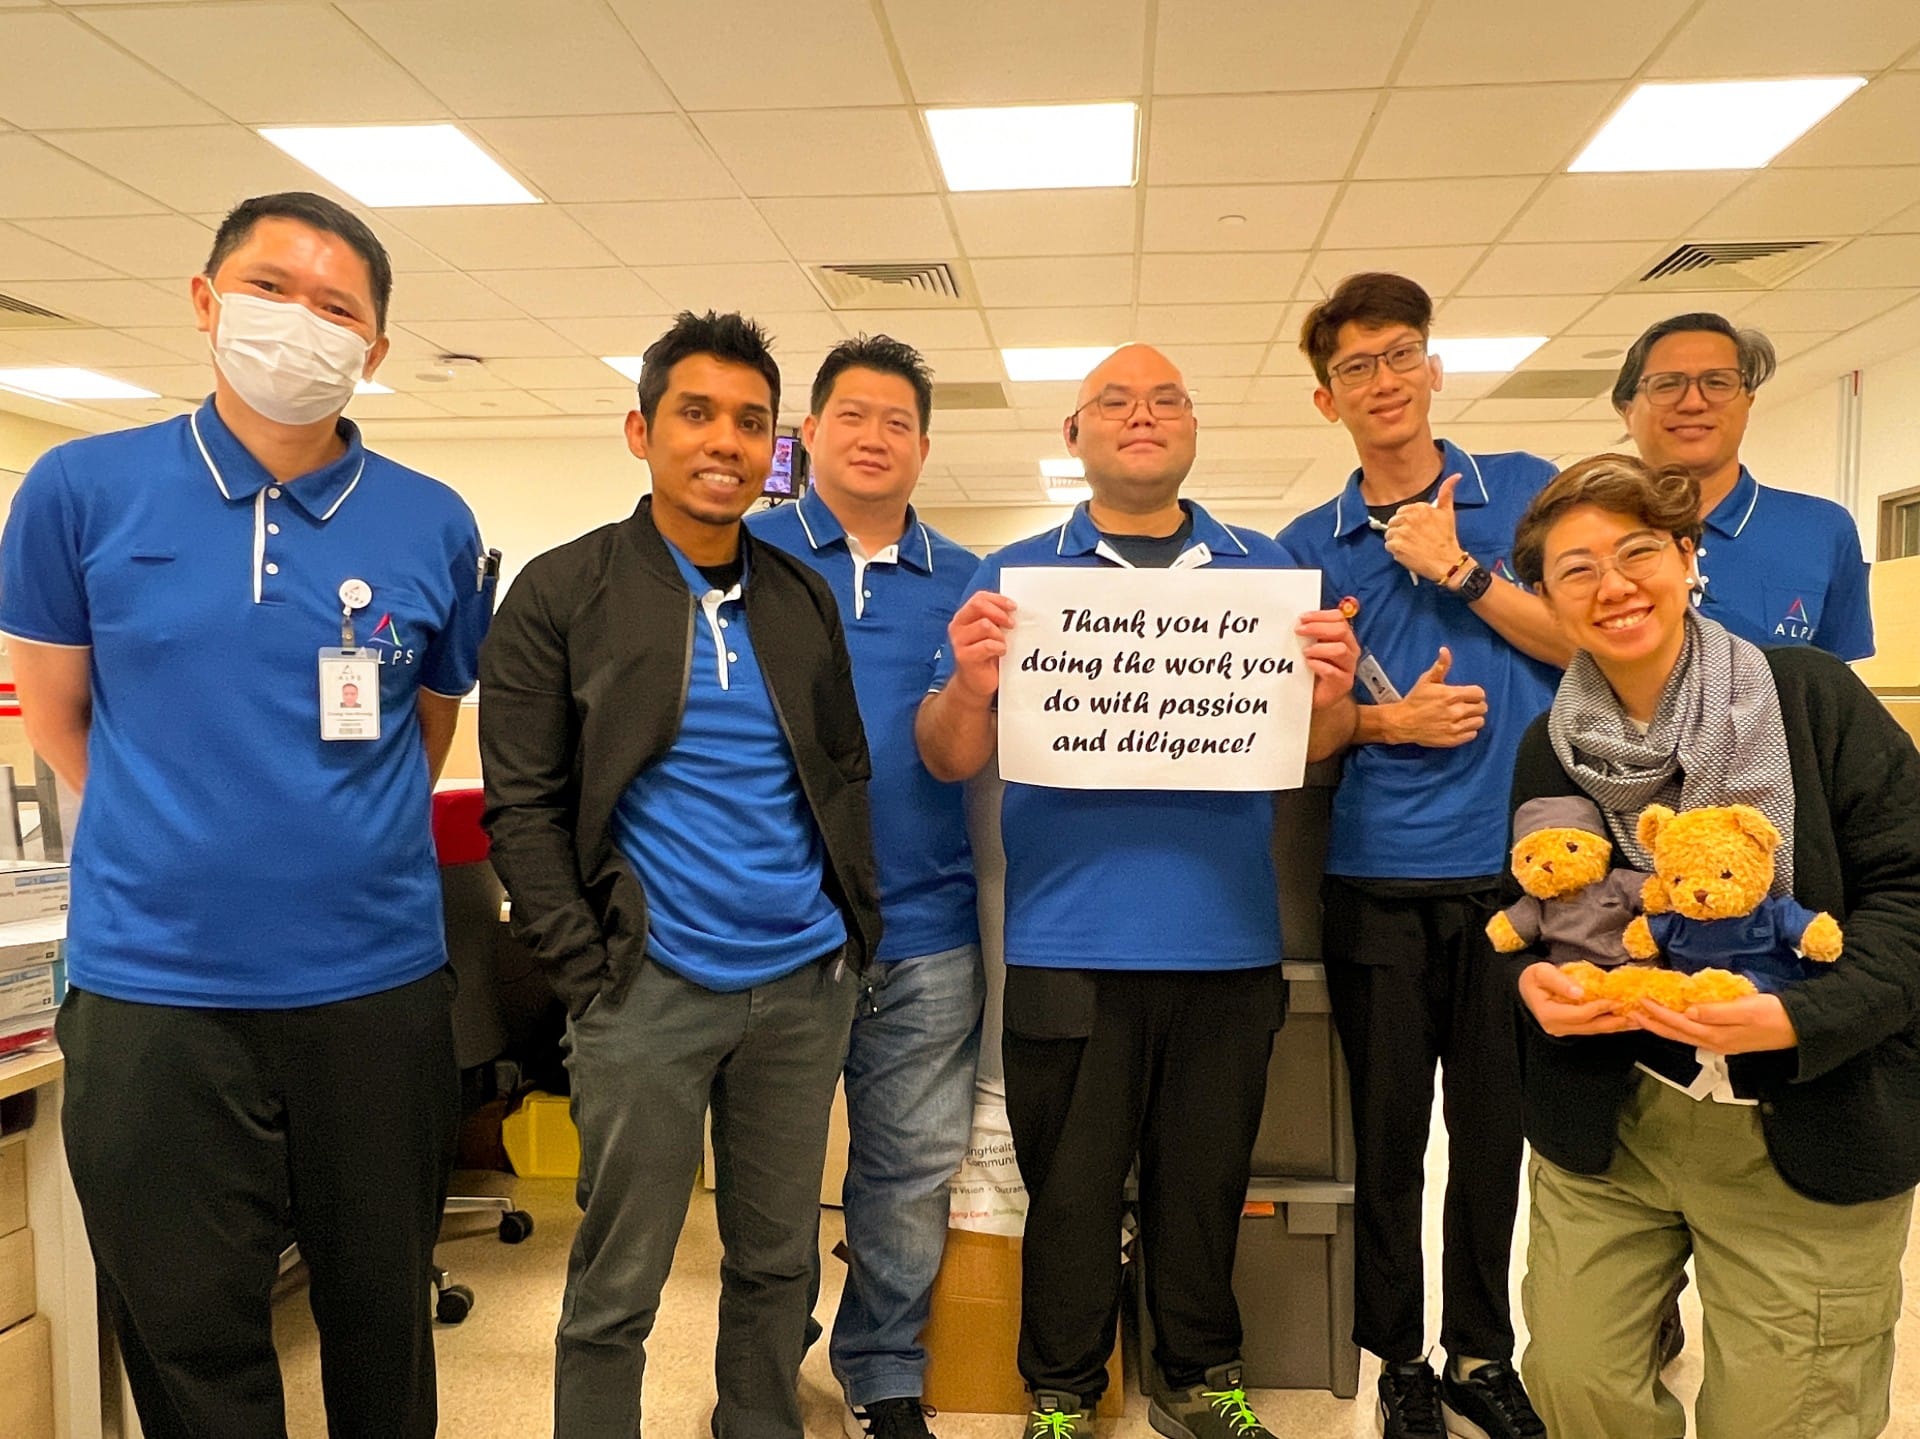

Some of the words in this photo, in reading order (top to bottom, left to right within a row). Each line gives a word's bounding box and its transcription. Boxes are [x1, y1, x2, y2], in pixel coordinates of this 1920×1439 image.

[1061, 608, 1146, 639] Thank
[1155, 616, 1209, 639] you
[1218, 610, 1259, 640] for
[1021, 648, 1103, 681] doing
[1113, 650, 1156, 674] the
[1165, 651, 1233, 680] work
[1241, 657, 1294, 680] you
[1043, 688, 1080, 712] do
[1090, 690, 1149, 715] with
[1158, 691, 1268, 720] passion
[1052, 728, 1107, 752] and
[1117, 729, 1257, 760] diligence!
[966, 1142, 1014, 1158] ingHealt
